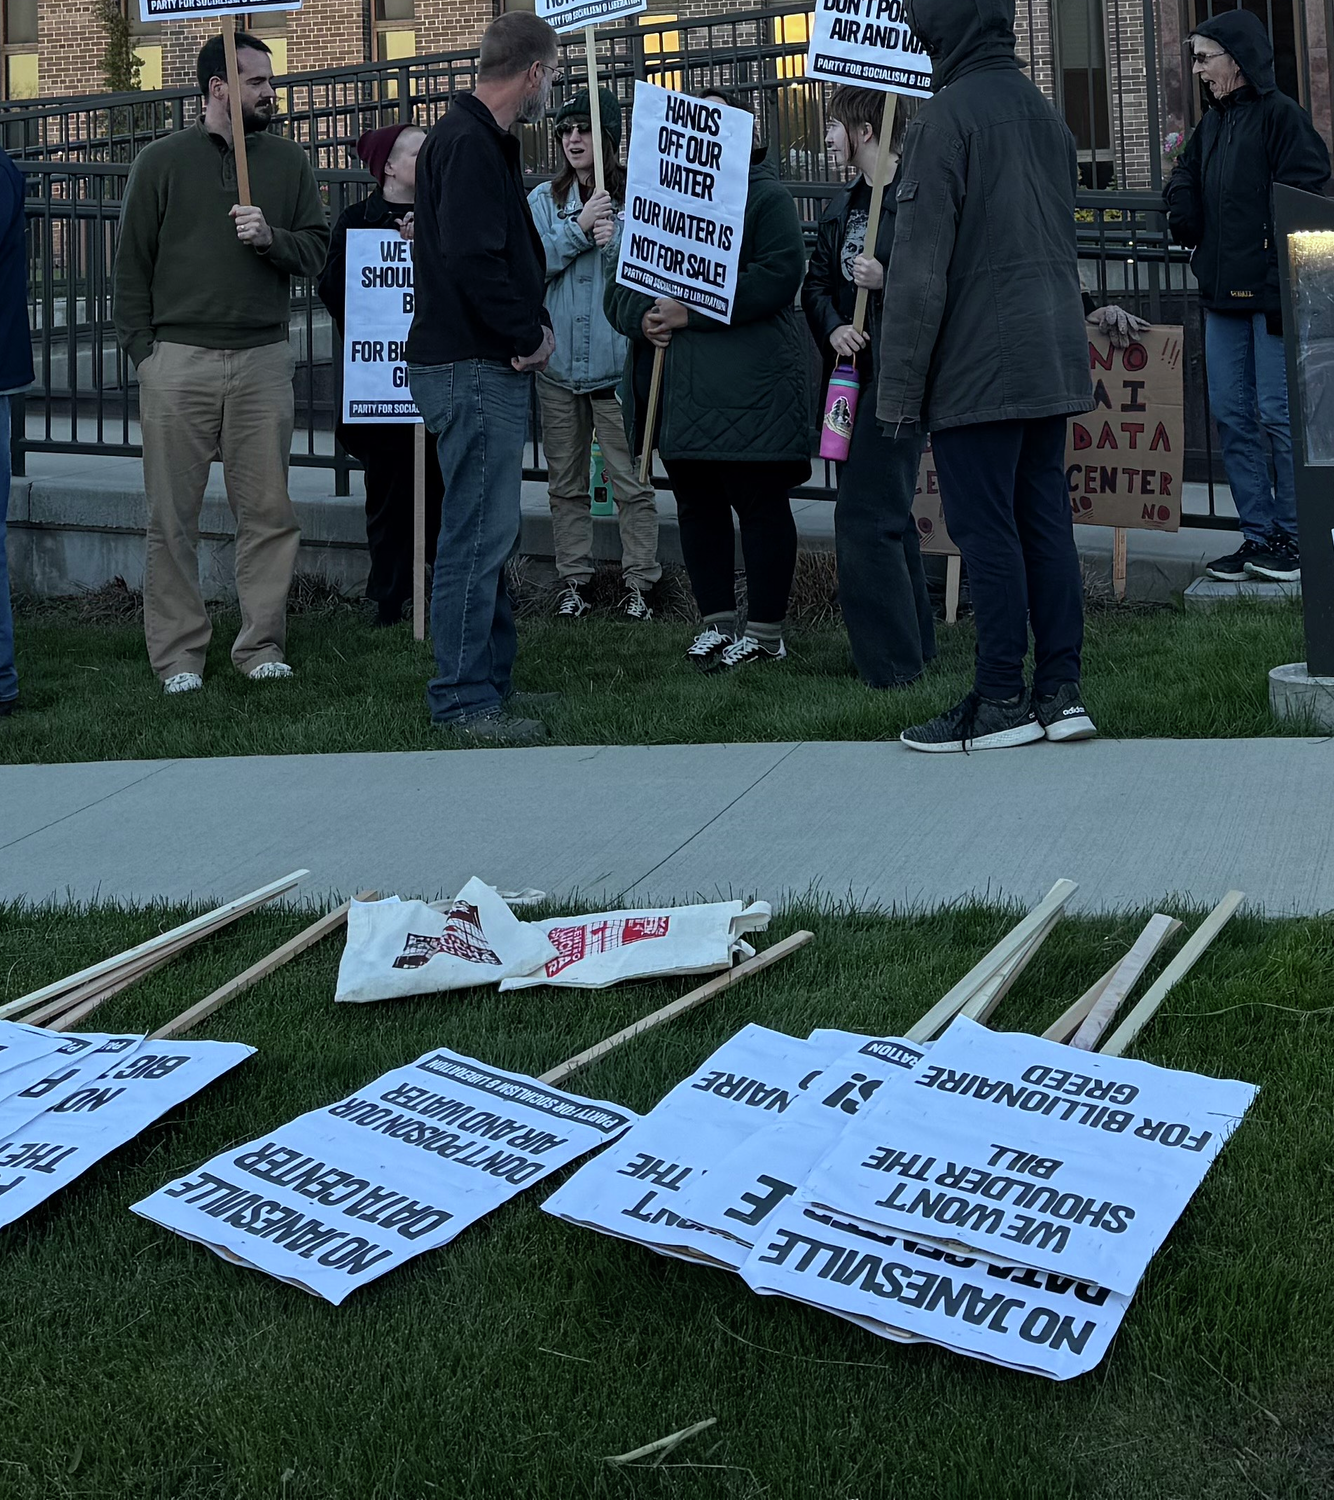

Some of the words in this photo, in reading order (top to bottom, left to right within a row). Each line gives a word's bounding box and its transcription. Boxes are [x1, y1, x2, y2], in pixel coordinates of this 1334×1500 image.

[830, 18, 861, 44] AIR
[861, 23, 900, 50] AND
[817, 57, 844, 72] PARTY
[845, 62, 862, 75] FOR
[863, 65, 908, 84] SOCIALISM
[665, 95, 721, 136] HANDS
[658, 126, 685, 158] OFF
[686, 135, 722, 171] OUR
[659, 158, 714, 201] WATER
[633, 195, 661, 227] OUR
[662, 204, 716, 246] WATER
[718, 223, 733, 251] IS
[380, 241, 407, 262] WE
[630, 232, 657, 263] NOT
[657, 245, 685, 275] FOR
[686, 253, 727, 288] SALE!
[351, 341, 384, 362] FOR
[1089, 342, 1148, 371] NO
[353, 404, 377, 414] PARTY
[378, 404, 393, 413] FOR
[1093, 378, 1146, 412] AI
[1073, 421, 1171, 452] DATA
[1067, 464, 1172, 496] CENTER
[1141, 503, 1171, 521] NO
[1062, 706, 1085, 716] adida
[114, 1055, 191, 1079] BIG
[426, 1059, 485, 1090] LIBERATION
[1020, 1064, 1140, 1105] GREED
[328, 1097, 386, 1128] OUR
[380, 1082, 468, 1126] WATER
[498, 1082, 558, 1113] SOCIALISM
[555, 1101, 581, 1119] FOR
[916, 1066, 1136, 1134] BILLIONAIRE
[459, 1111, 520, 1141] AND
[581, 1107, 619, 1129] PARTY
[1133, 1118, 1212, 1153] FOR
[372, 1112, 468, 1160] POISON
[506, 1127, 568, 1155] AIR
[233, 1142, 370, 1206] CENTER
[616, 1152, 693, 1192] THE
[860, 1146, 938, 1182] THE
[988, 1143, 1064, 1180] BILL
[342, 1185, 454, 1241] DATA
[934, 1161, 1135, 1234] SHOULDER
[163, 1172, 351, 1259] JANESVILLE
[1001, 1214, 1072, 1254] WE
[317, 1236, 393, 1275] NO
[758, 1228, 1026, 1333] JANESVILLE
[1018, 1307, 1096, 1356] NO
